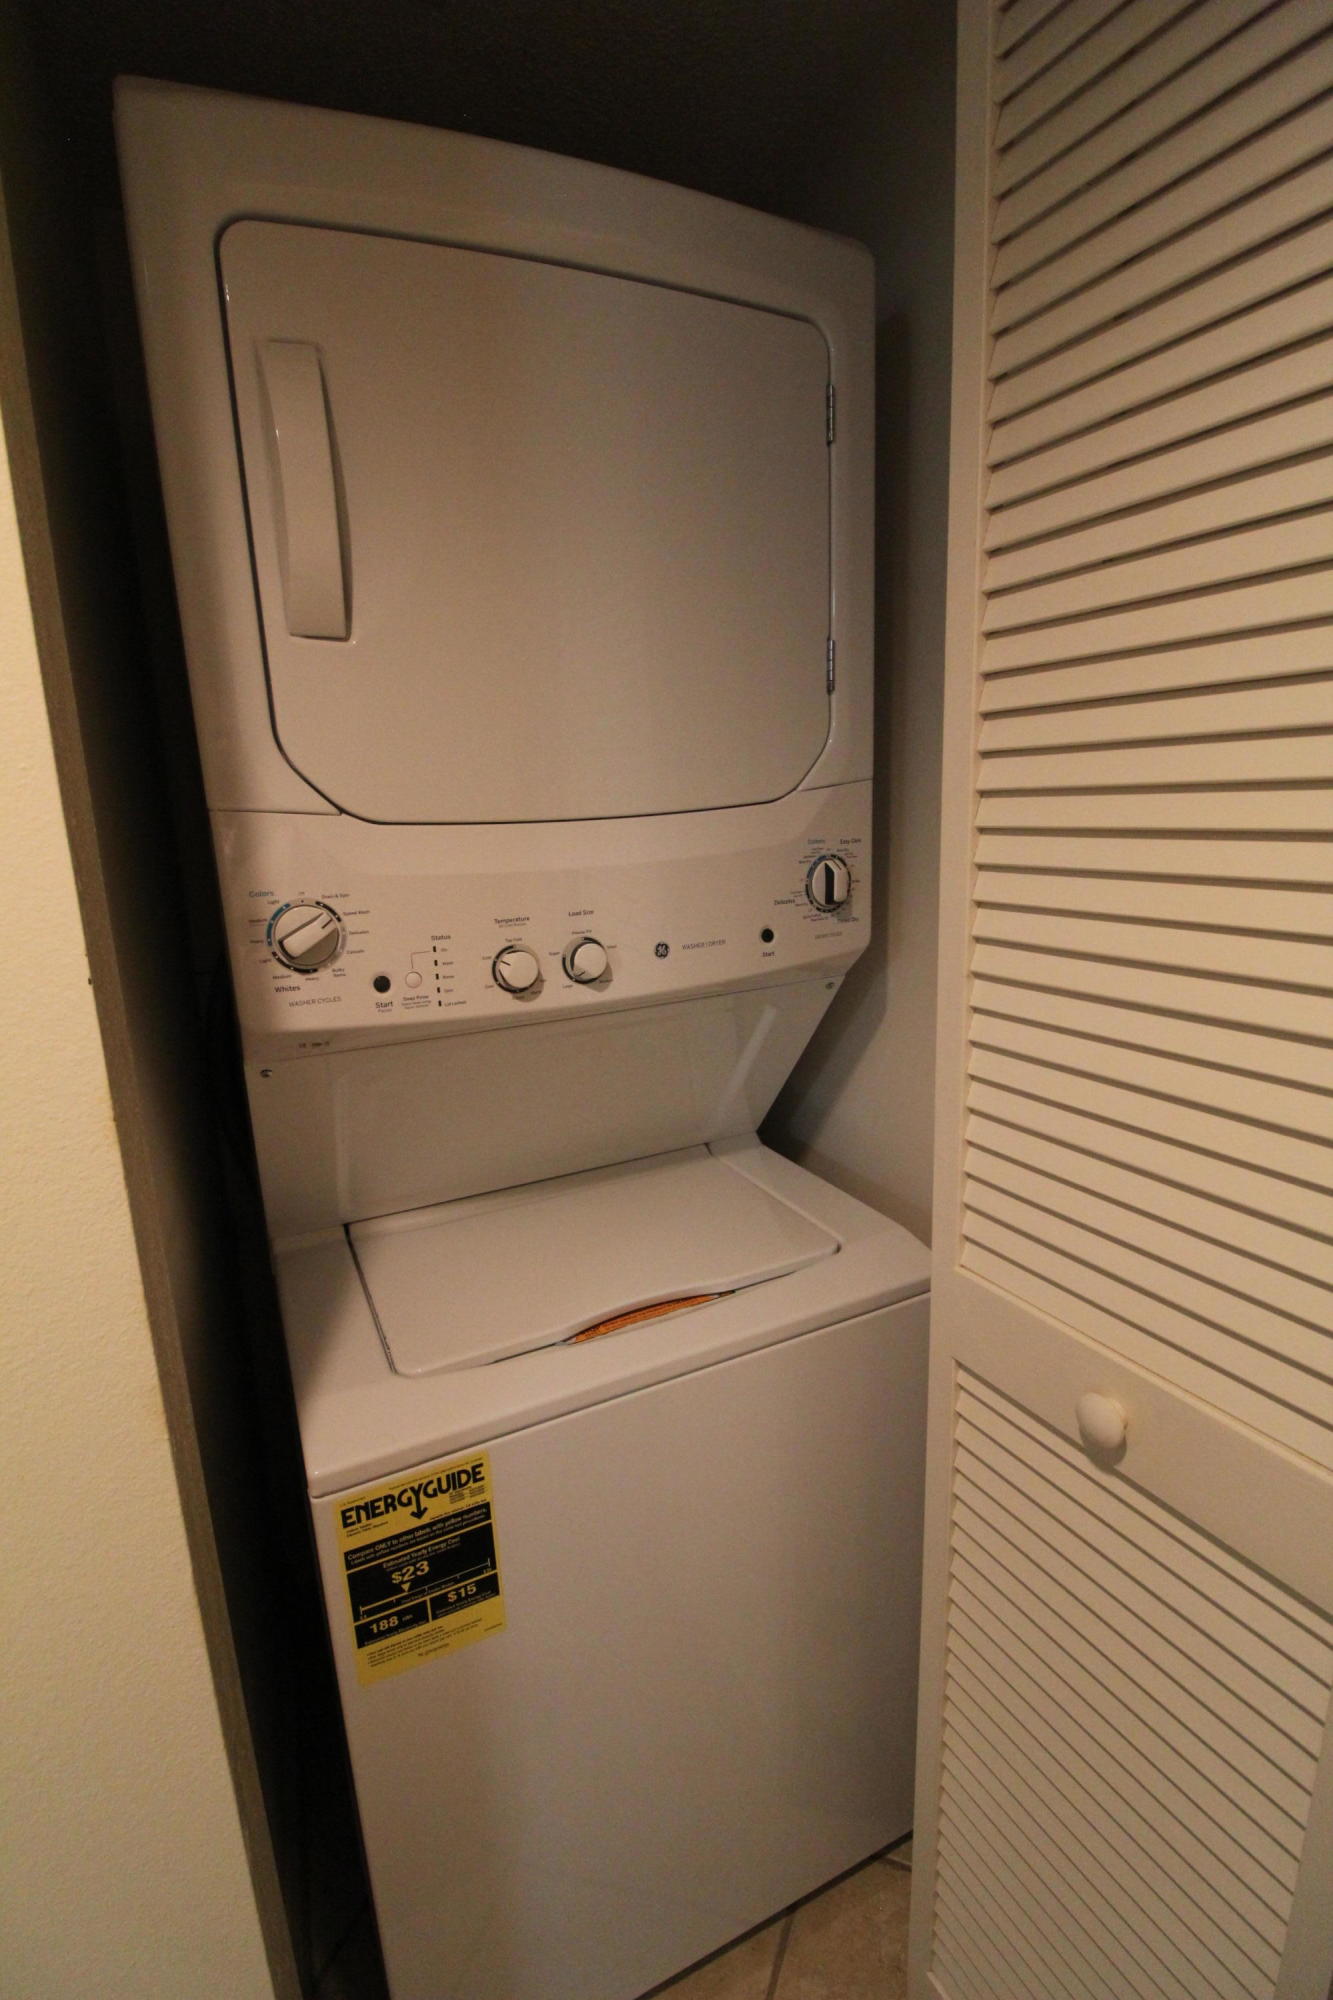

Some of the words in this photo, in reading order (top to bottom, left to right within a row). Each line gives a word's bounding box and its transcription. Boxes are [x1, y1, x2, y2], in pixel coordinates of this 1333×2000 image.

[494, 916, 530, 925] Temperature
[274, 985, 301, 993] Whites
[288, 1000, 315, 1008] WASHER
[375, 1001, 393, 1009] Start
[340, 1462, 485, 1529] ENERGYGUIDE
[391, 1560, 430, 1585] $23
[447, 1582, 477, 1602] $15
[369, 1615, 399, 1634] 188
